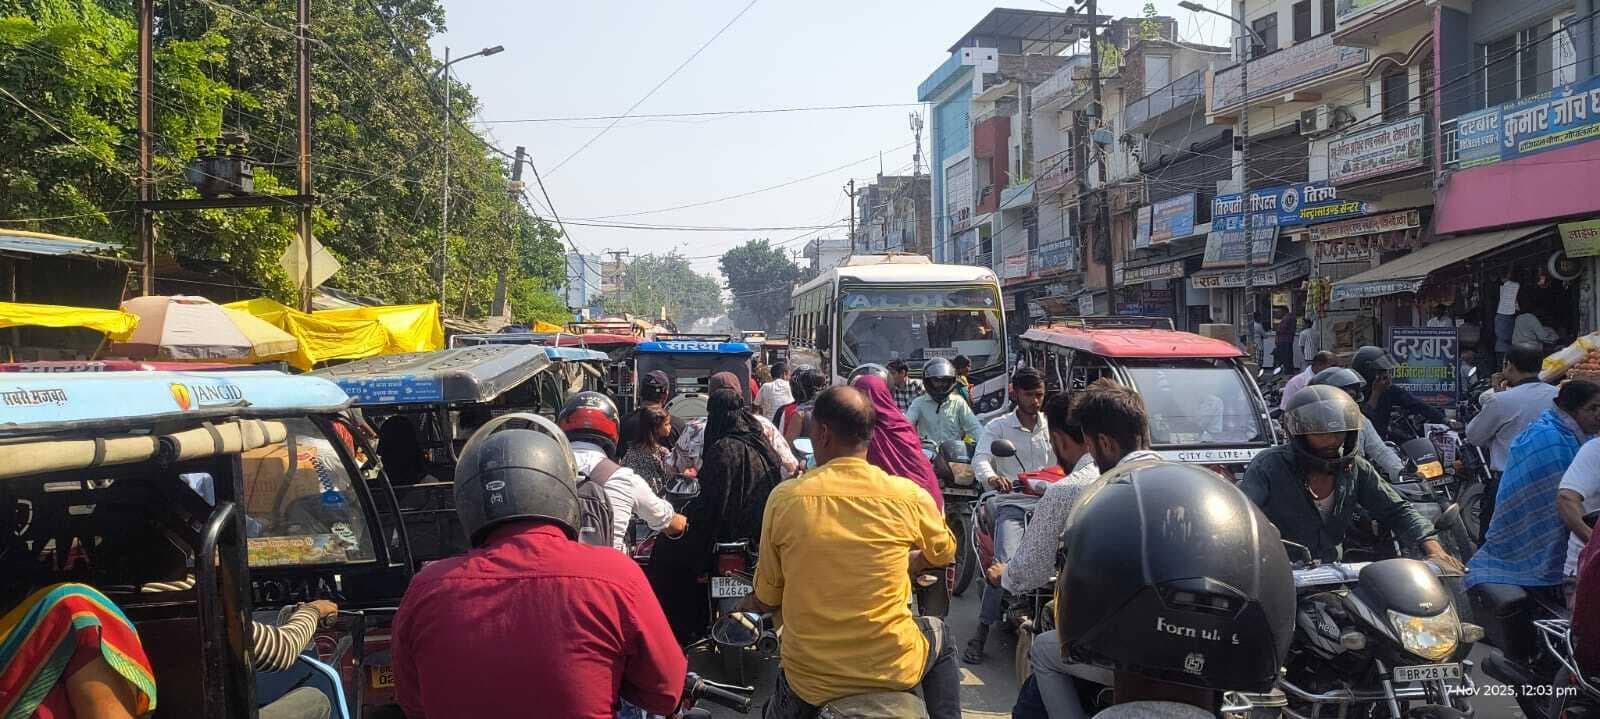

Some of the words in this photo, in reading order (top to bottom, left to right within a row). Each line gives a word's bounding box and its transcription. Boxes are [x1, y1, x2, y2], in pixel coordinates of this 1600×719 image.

[1459, 112, 1498, 136] दरबार
[1503, 103, 1549, 147] कुमार
[1393, 335, 1457, 360] दरबार
[0, 386, 31, 406] सबसे
[191, 385, 242, 401] JANGID
